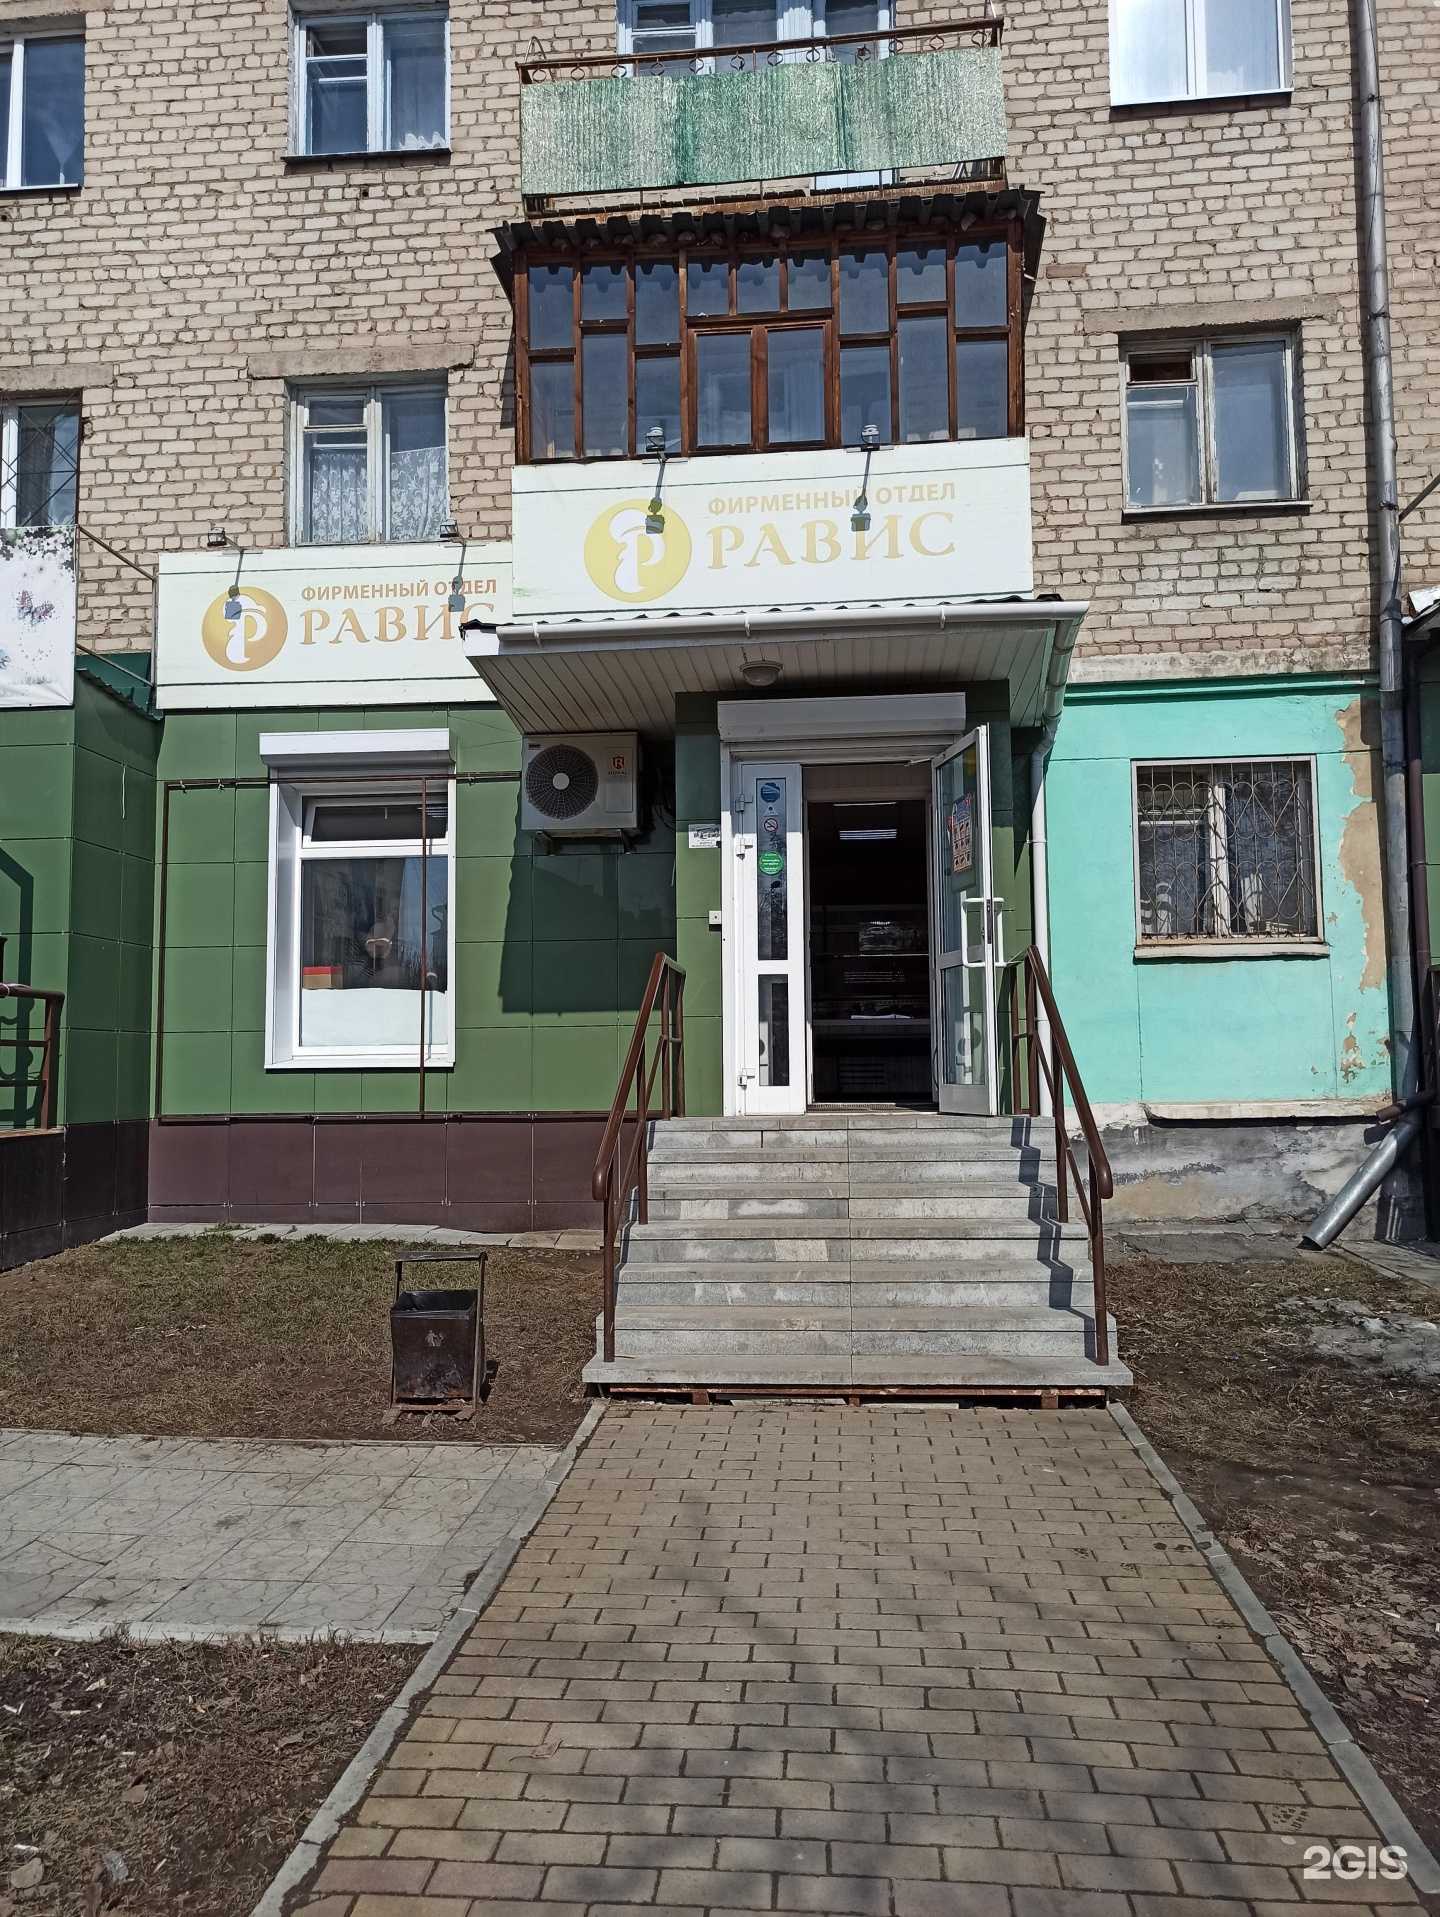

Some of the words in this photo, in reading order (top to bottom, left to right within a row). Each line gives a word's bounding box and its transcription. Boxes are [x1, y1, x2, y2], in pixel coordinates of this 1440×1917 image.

[876, 482, 956, 505] ОТДЕЛ
[706, 511, 956, 570] РАВИС
[301, 579, 429, 602] ФИРМЕННЫЙ
[434, 579, 497, 596] ОДЕЛ
